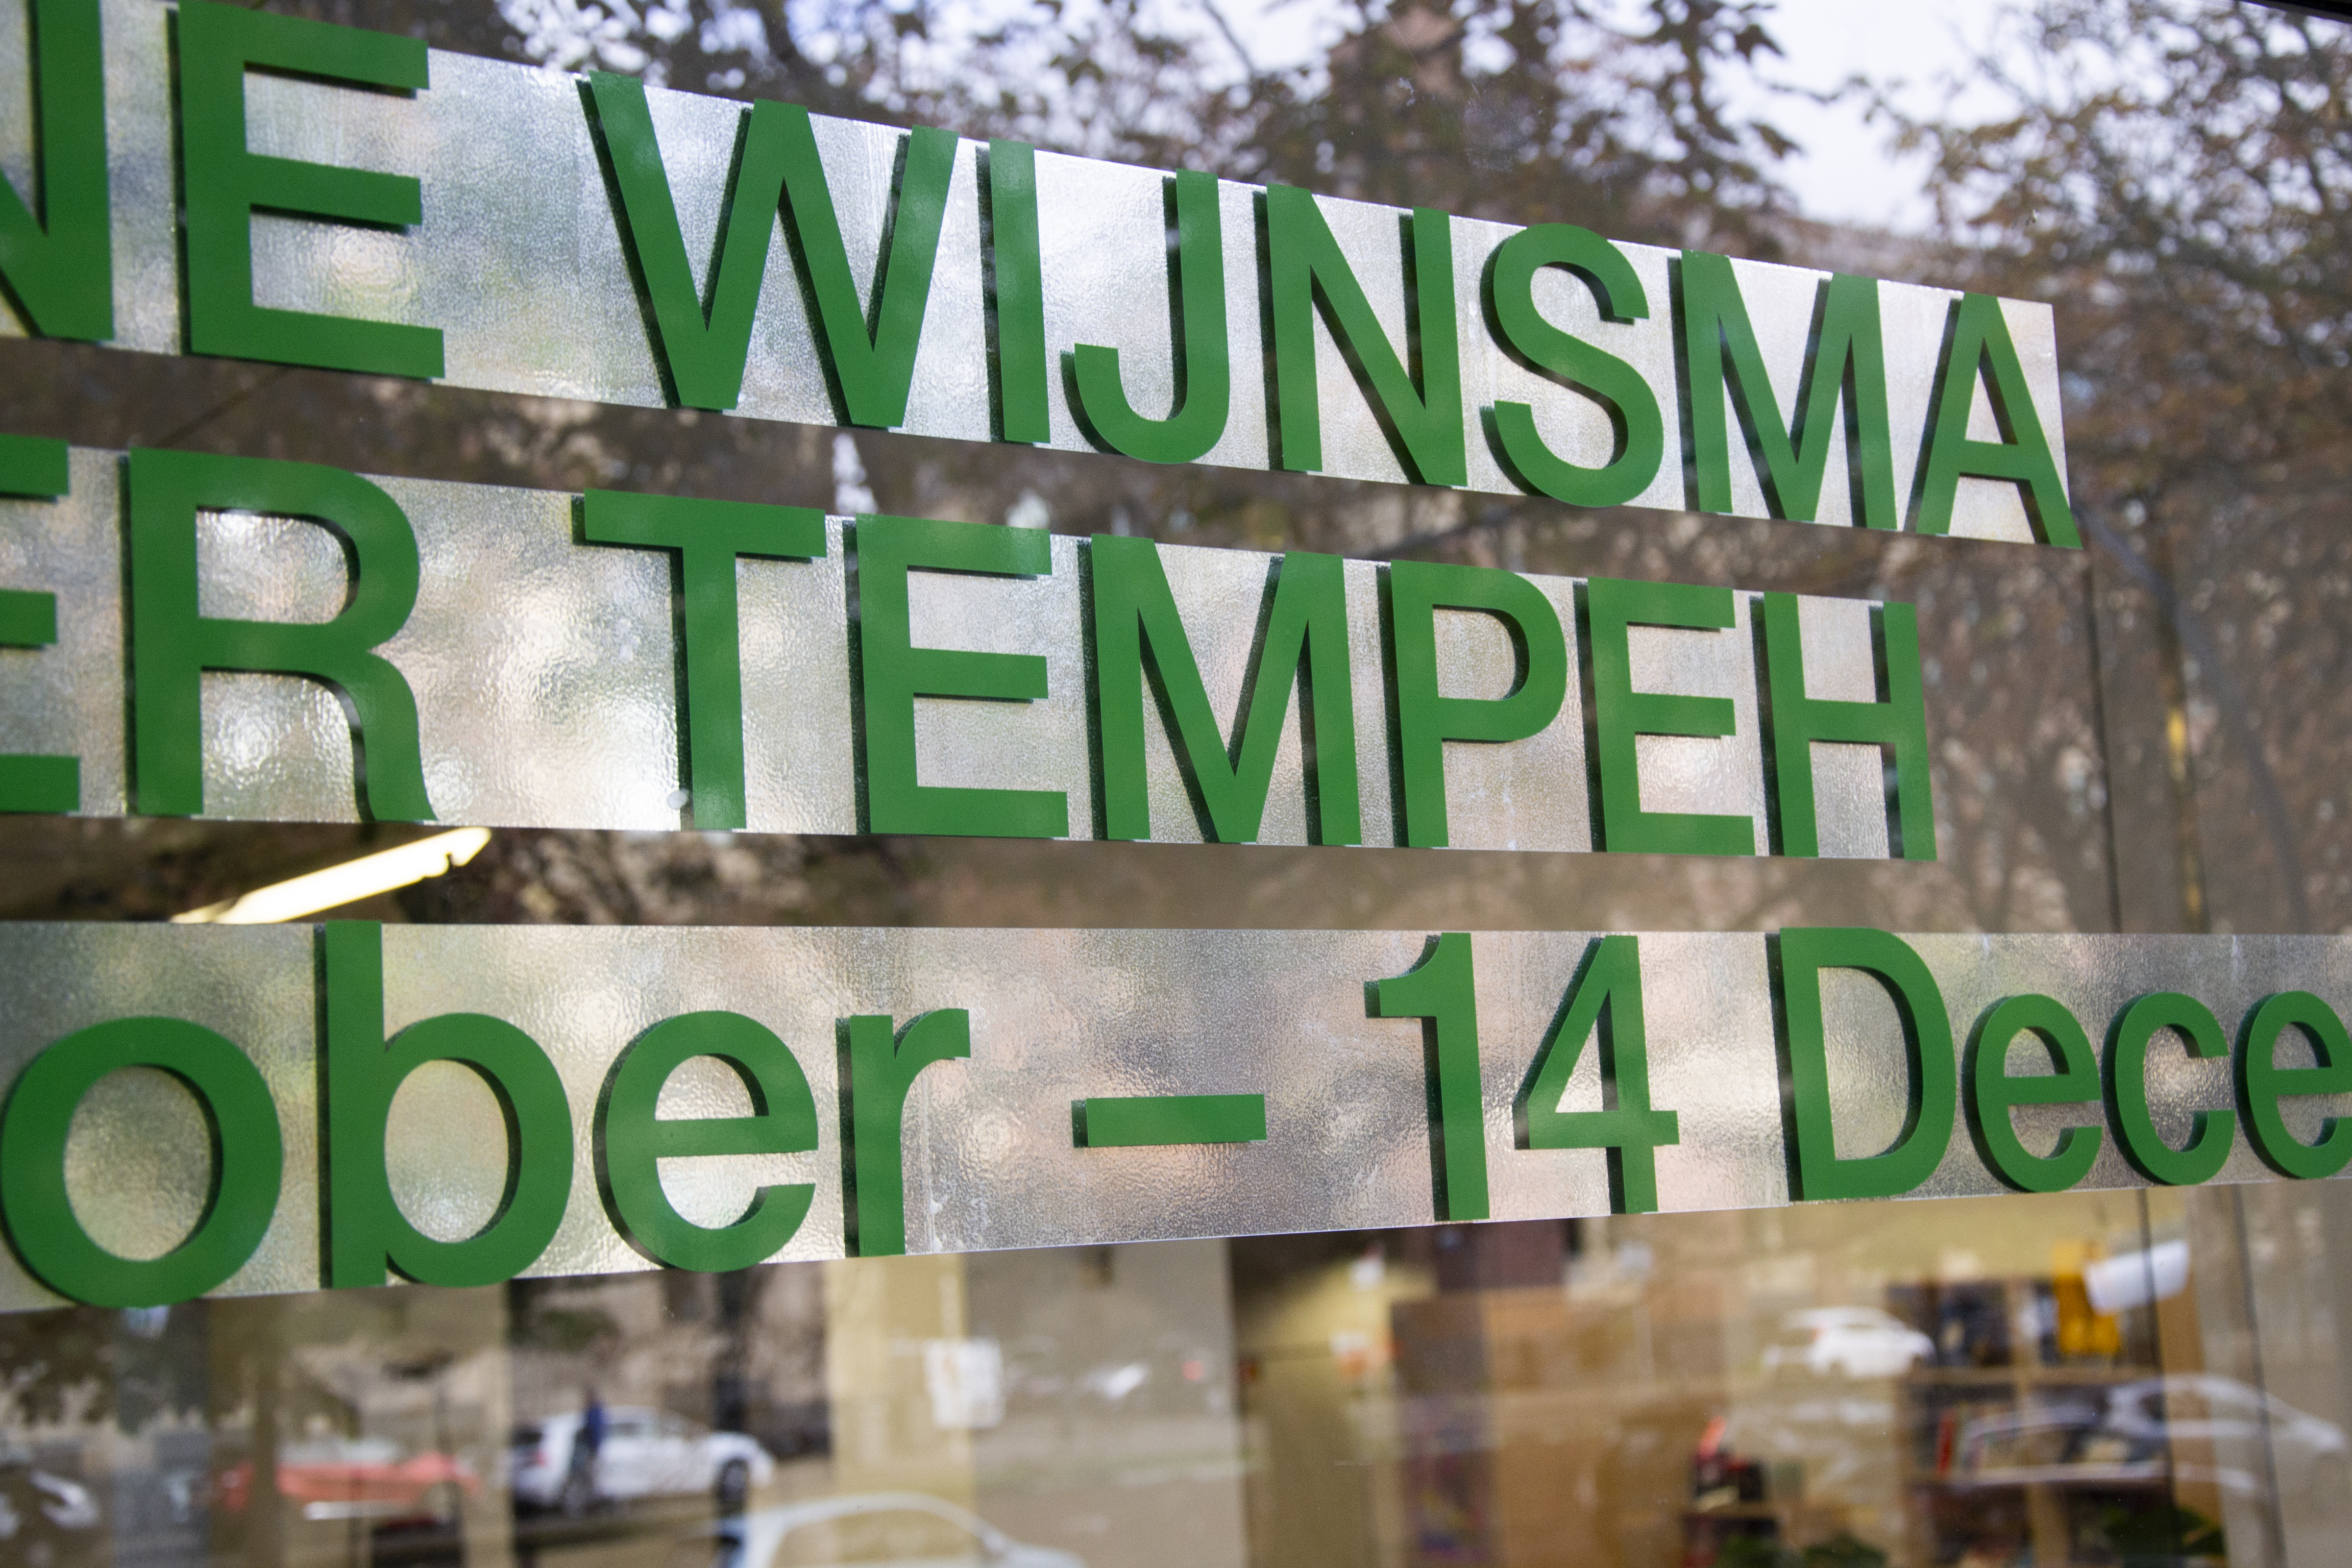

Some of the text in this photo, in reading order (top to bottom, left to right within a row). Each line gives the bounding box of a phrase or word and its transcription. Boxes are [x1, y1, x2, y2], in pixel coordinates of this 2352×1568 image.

[588, 78, 2081, 548] WIJNSMA
[582, 488, 1937, 861] TEMPEH
[2, 920, 970, 1309] ober
[1373, 933, 1679, 1221] 14
[1776, 927, 2352, 1201] Dece
